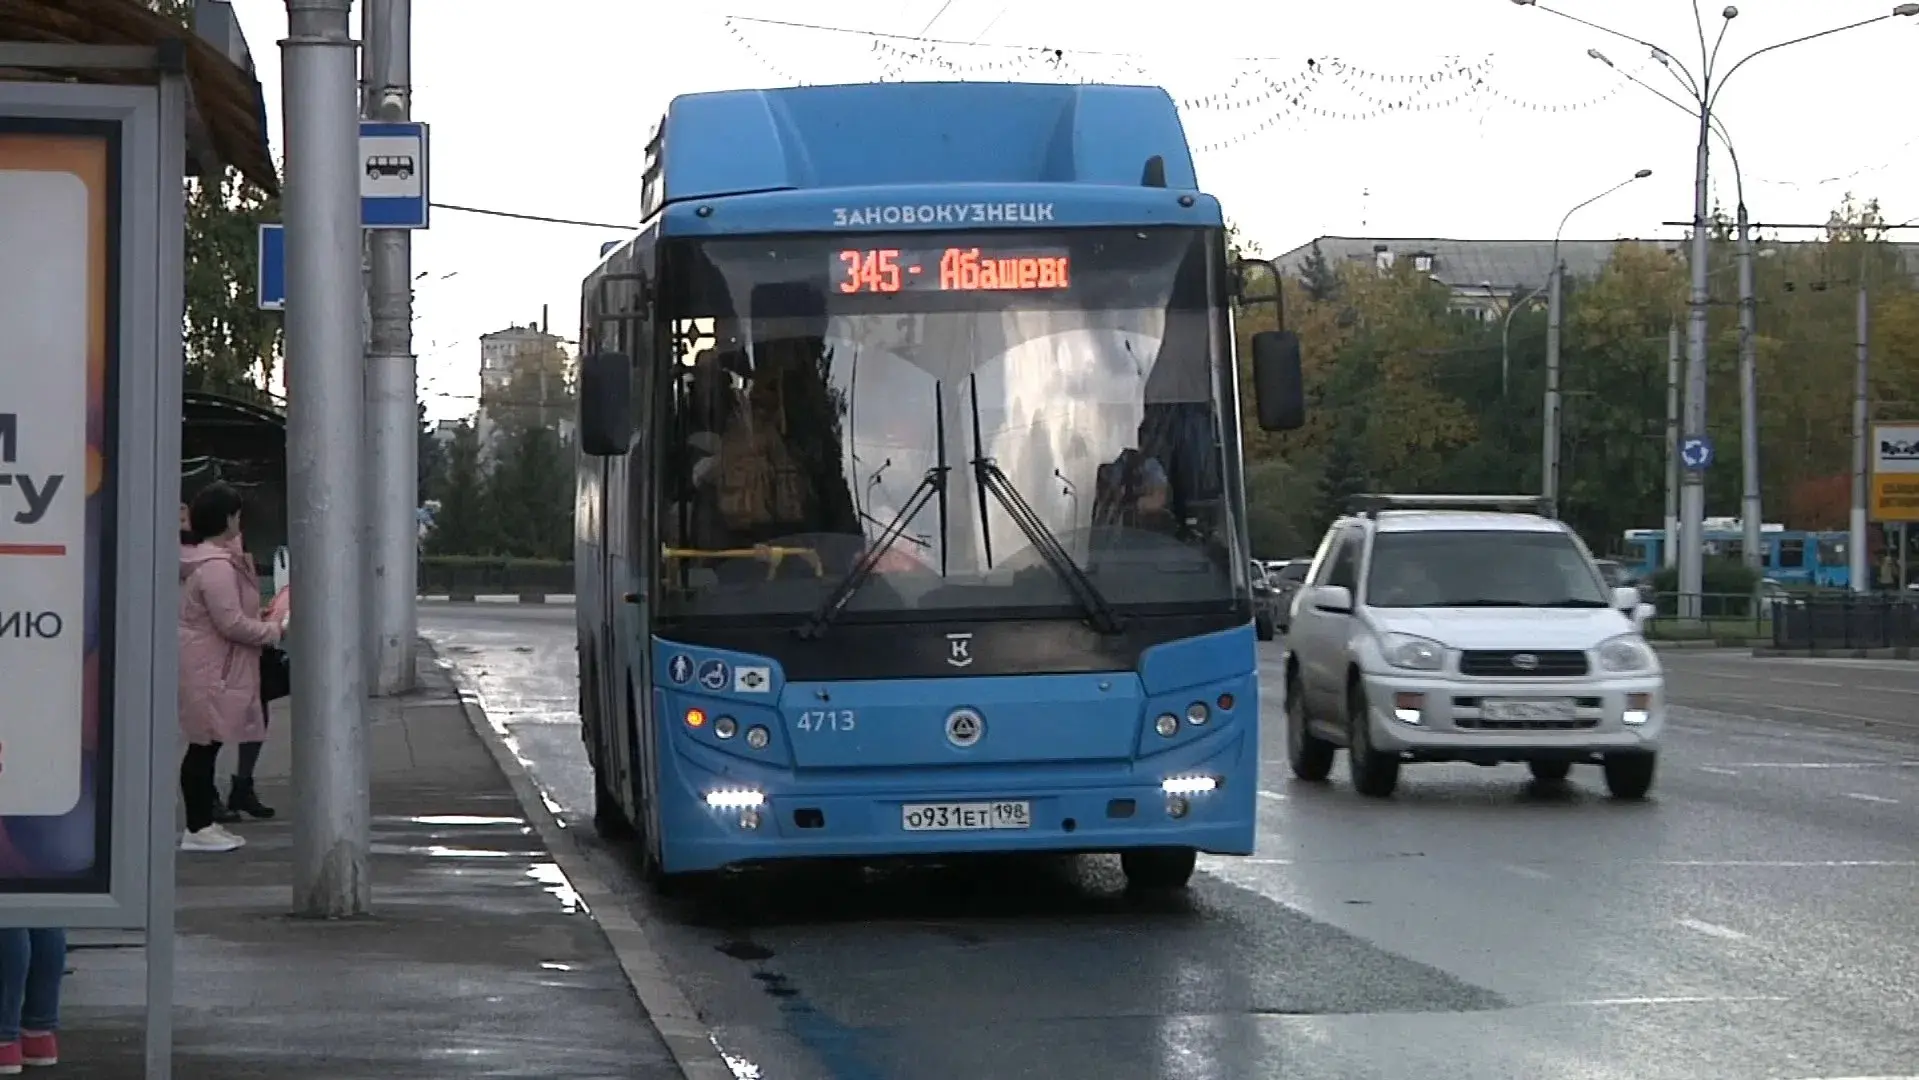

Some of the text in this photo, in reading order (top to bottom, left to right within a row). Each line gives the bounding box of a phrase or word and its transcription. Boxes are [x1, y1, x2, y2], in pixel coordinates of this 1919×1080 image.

[833, 203, 1054, 226] ЗАНОВОКУЗНЕЦК
[840, 250, 900, 292] 345
[797, 710, 855, 732] 4713
